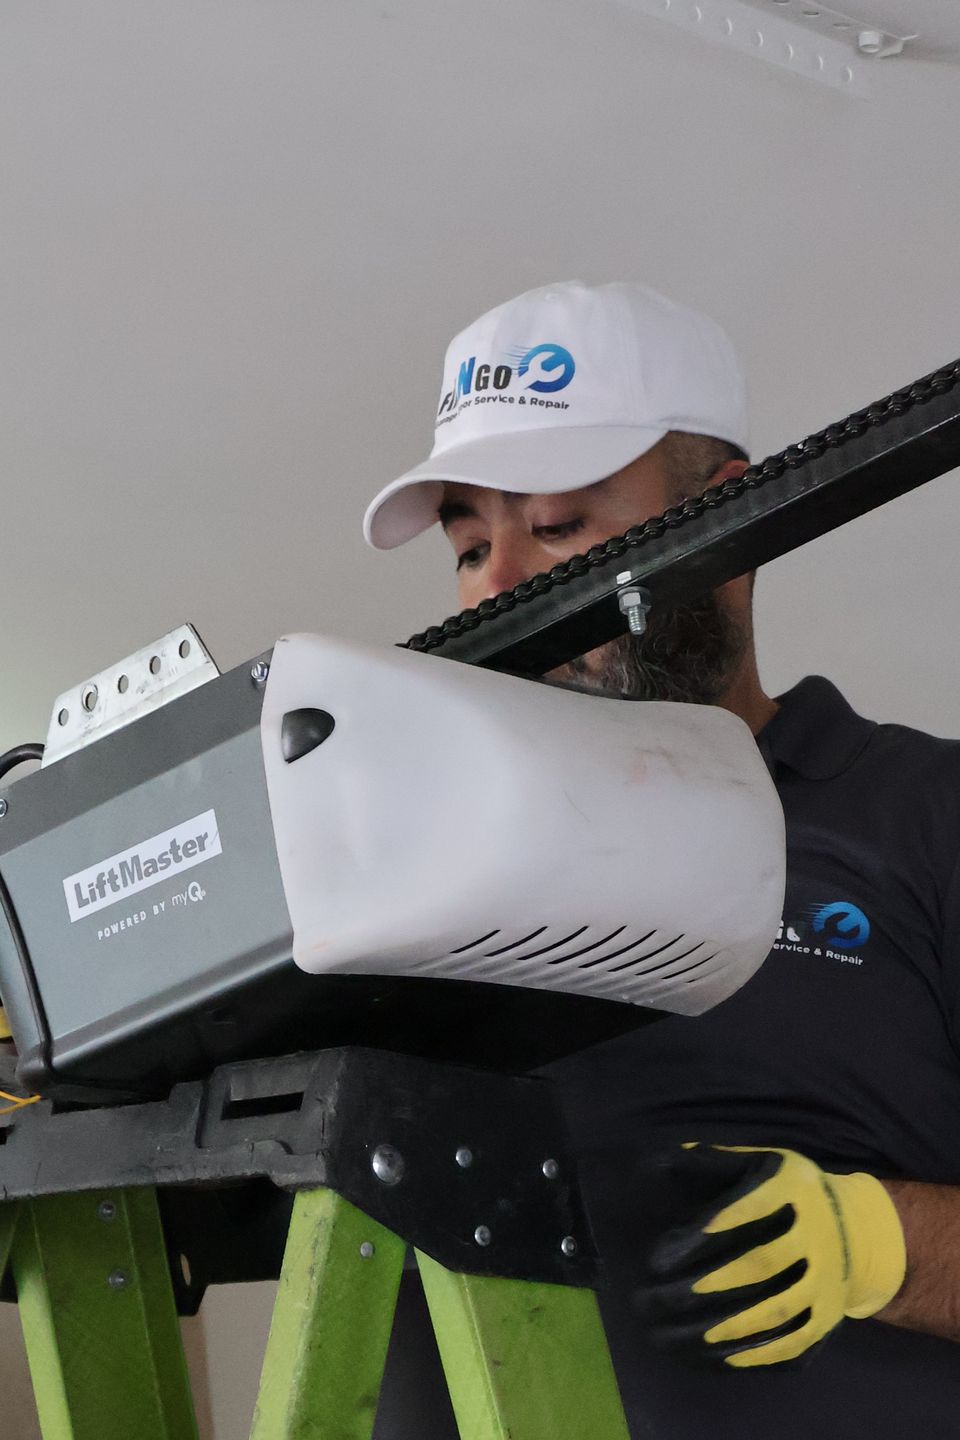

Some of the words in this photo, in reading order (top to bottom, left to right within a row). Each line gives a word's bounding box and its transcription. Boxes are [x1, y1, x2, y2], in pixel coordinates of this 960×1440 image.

[474, 394, 515, 406] Service
[518, 396, 527, 405] &
[530, 397, 570, 410] Repair
[74, 831, 209, 909] LiftMaster
[97, 910, 147, 941] POWERED
[152, 901, 166, 916] BY
[773, 942, 810, 954] ervice
[813, 947, 822, 956] &
[826, 950, 864, 966] Repair
